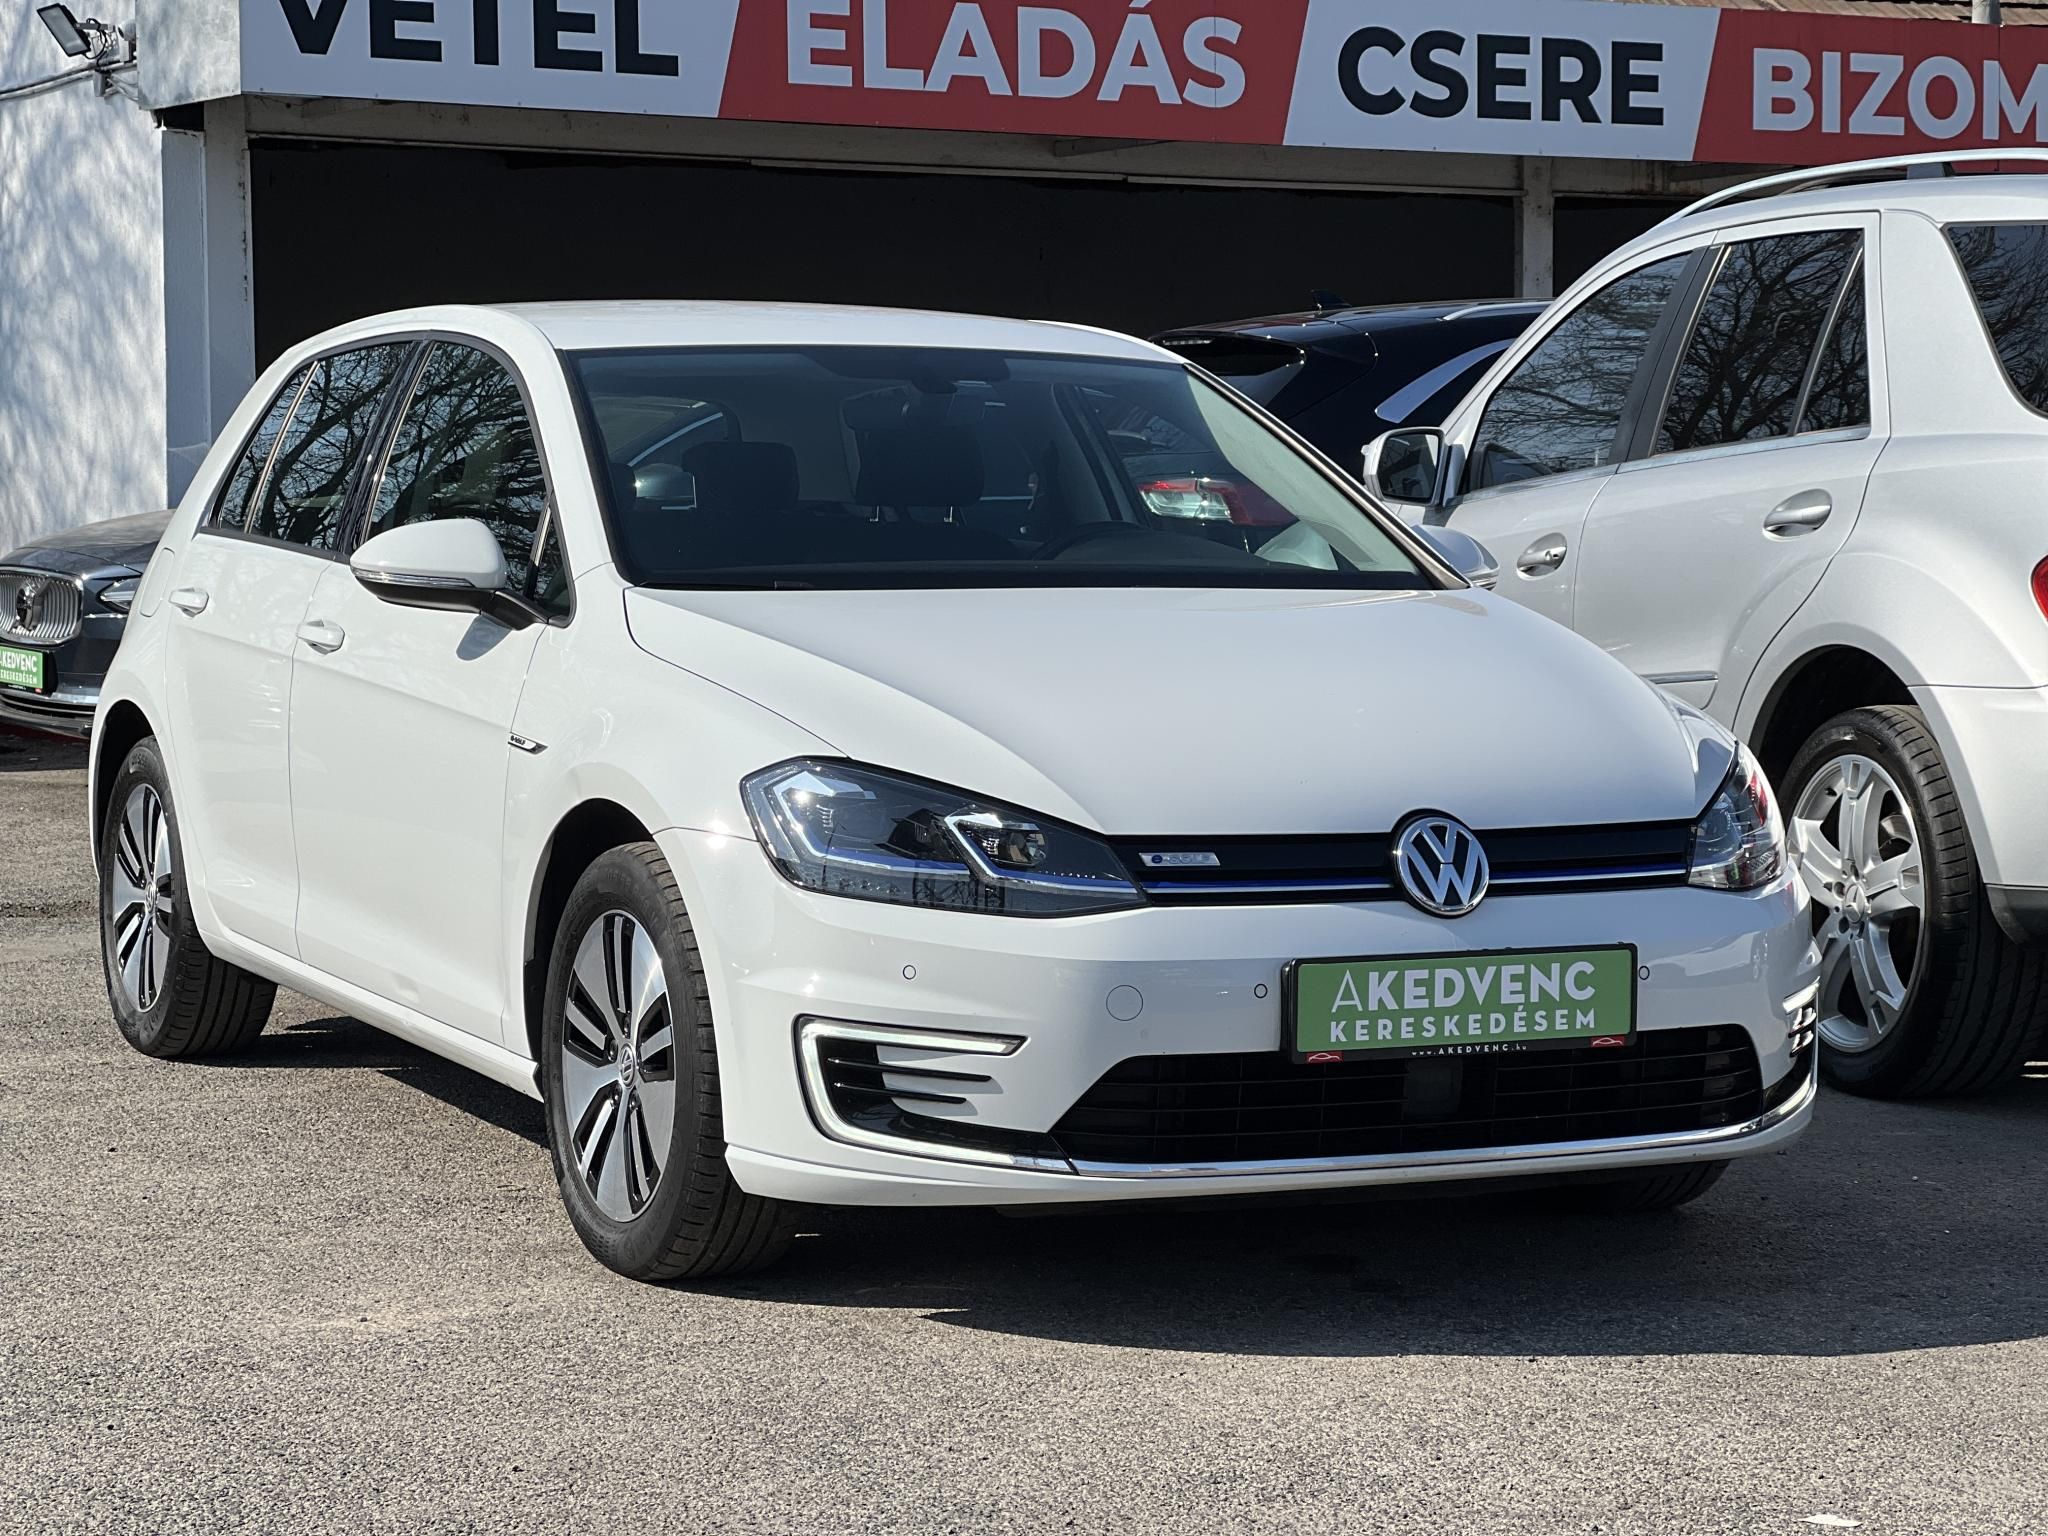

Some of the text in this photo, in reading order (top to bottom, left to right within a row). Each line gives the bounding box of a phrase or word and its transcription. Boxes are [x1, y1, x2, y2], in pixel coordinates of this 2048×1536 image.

[787, 0, 1246, 108] ELADÁS
[1337, 26, 1664, 126] CSERE
[1331, 961, 1596, 1013] AKEDVENC
[1330, 1006, 1596, 1043] KERESKEDÉSEM
